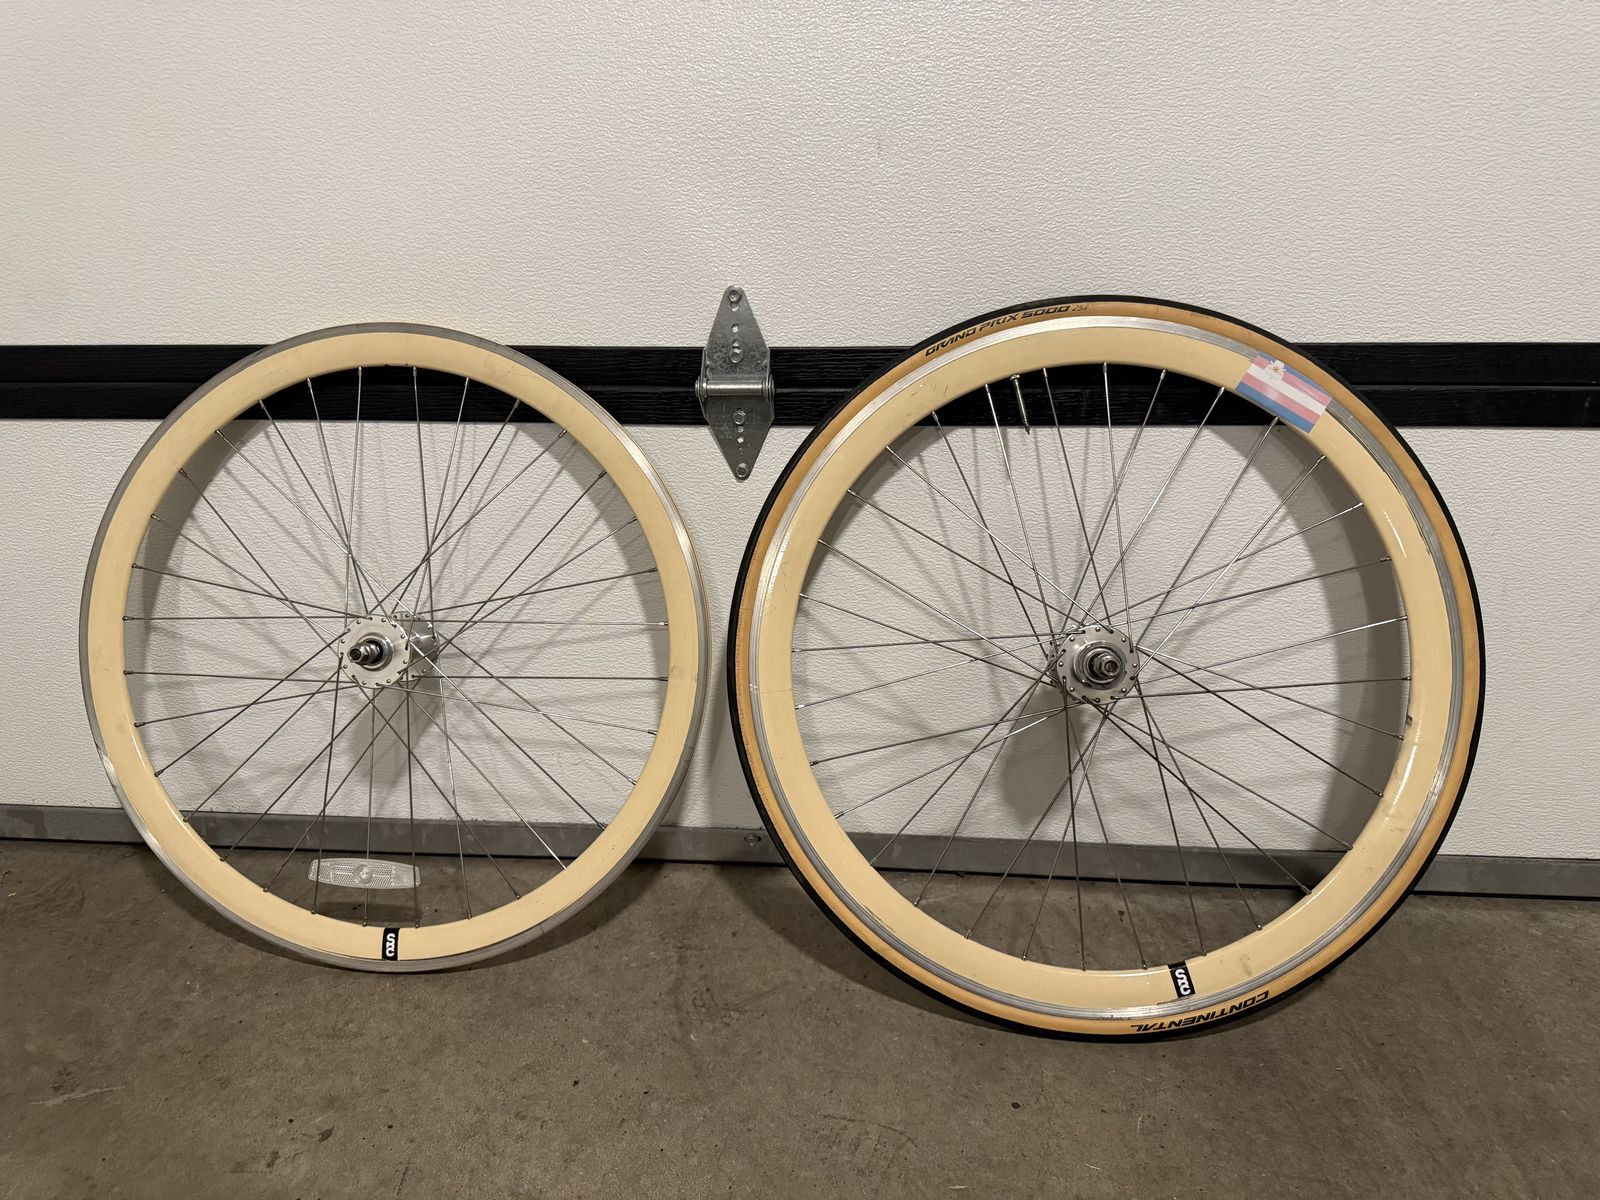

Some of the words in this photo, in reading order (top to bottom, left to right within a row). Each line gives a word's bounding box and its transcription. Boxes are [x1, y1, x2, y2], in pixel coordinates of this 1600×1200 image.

[925, 327, 977, 357] GRAND
[979, 313, 1018, 332] PRIX
[1021, 305, 1071, 319] 5000
[1130, 990, 1270, 1032] CONTINENTAL
